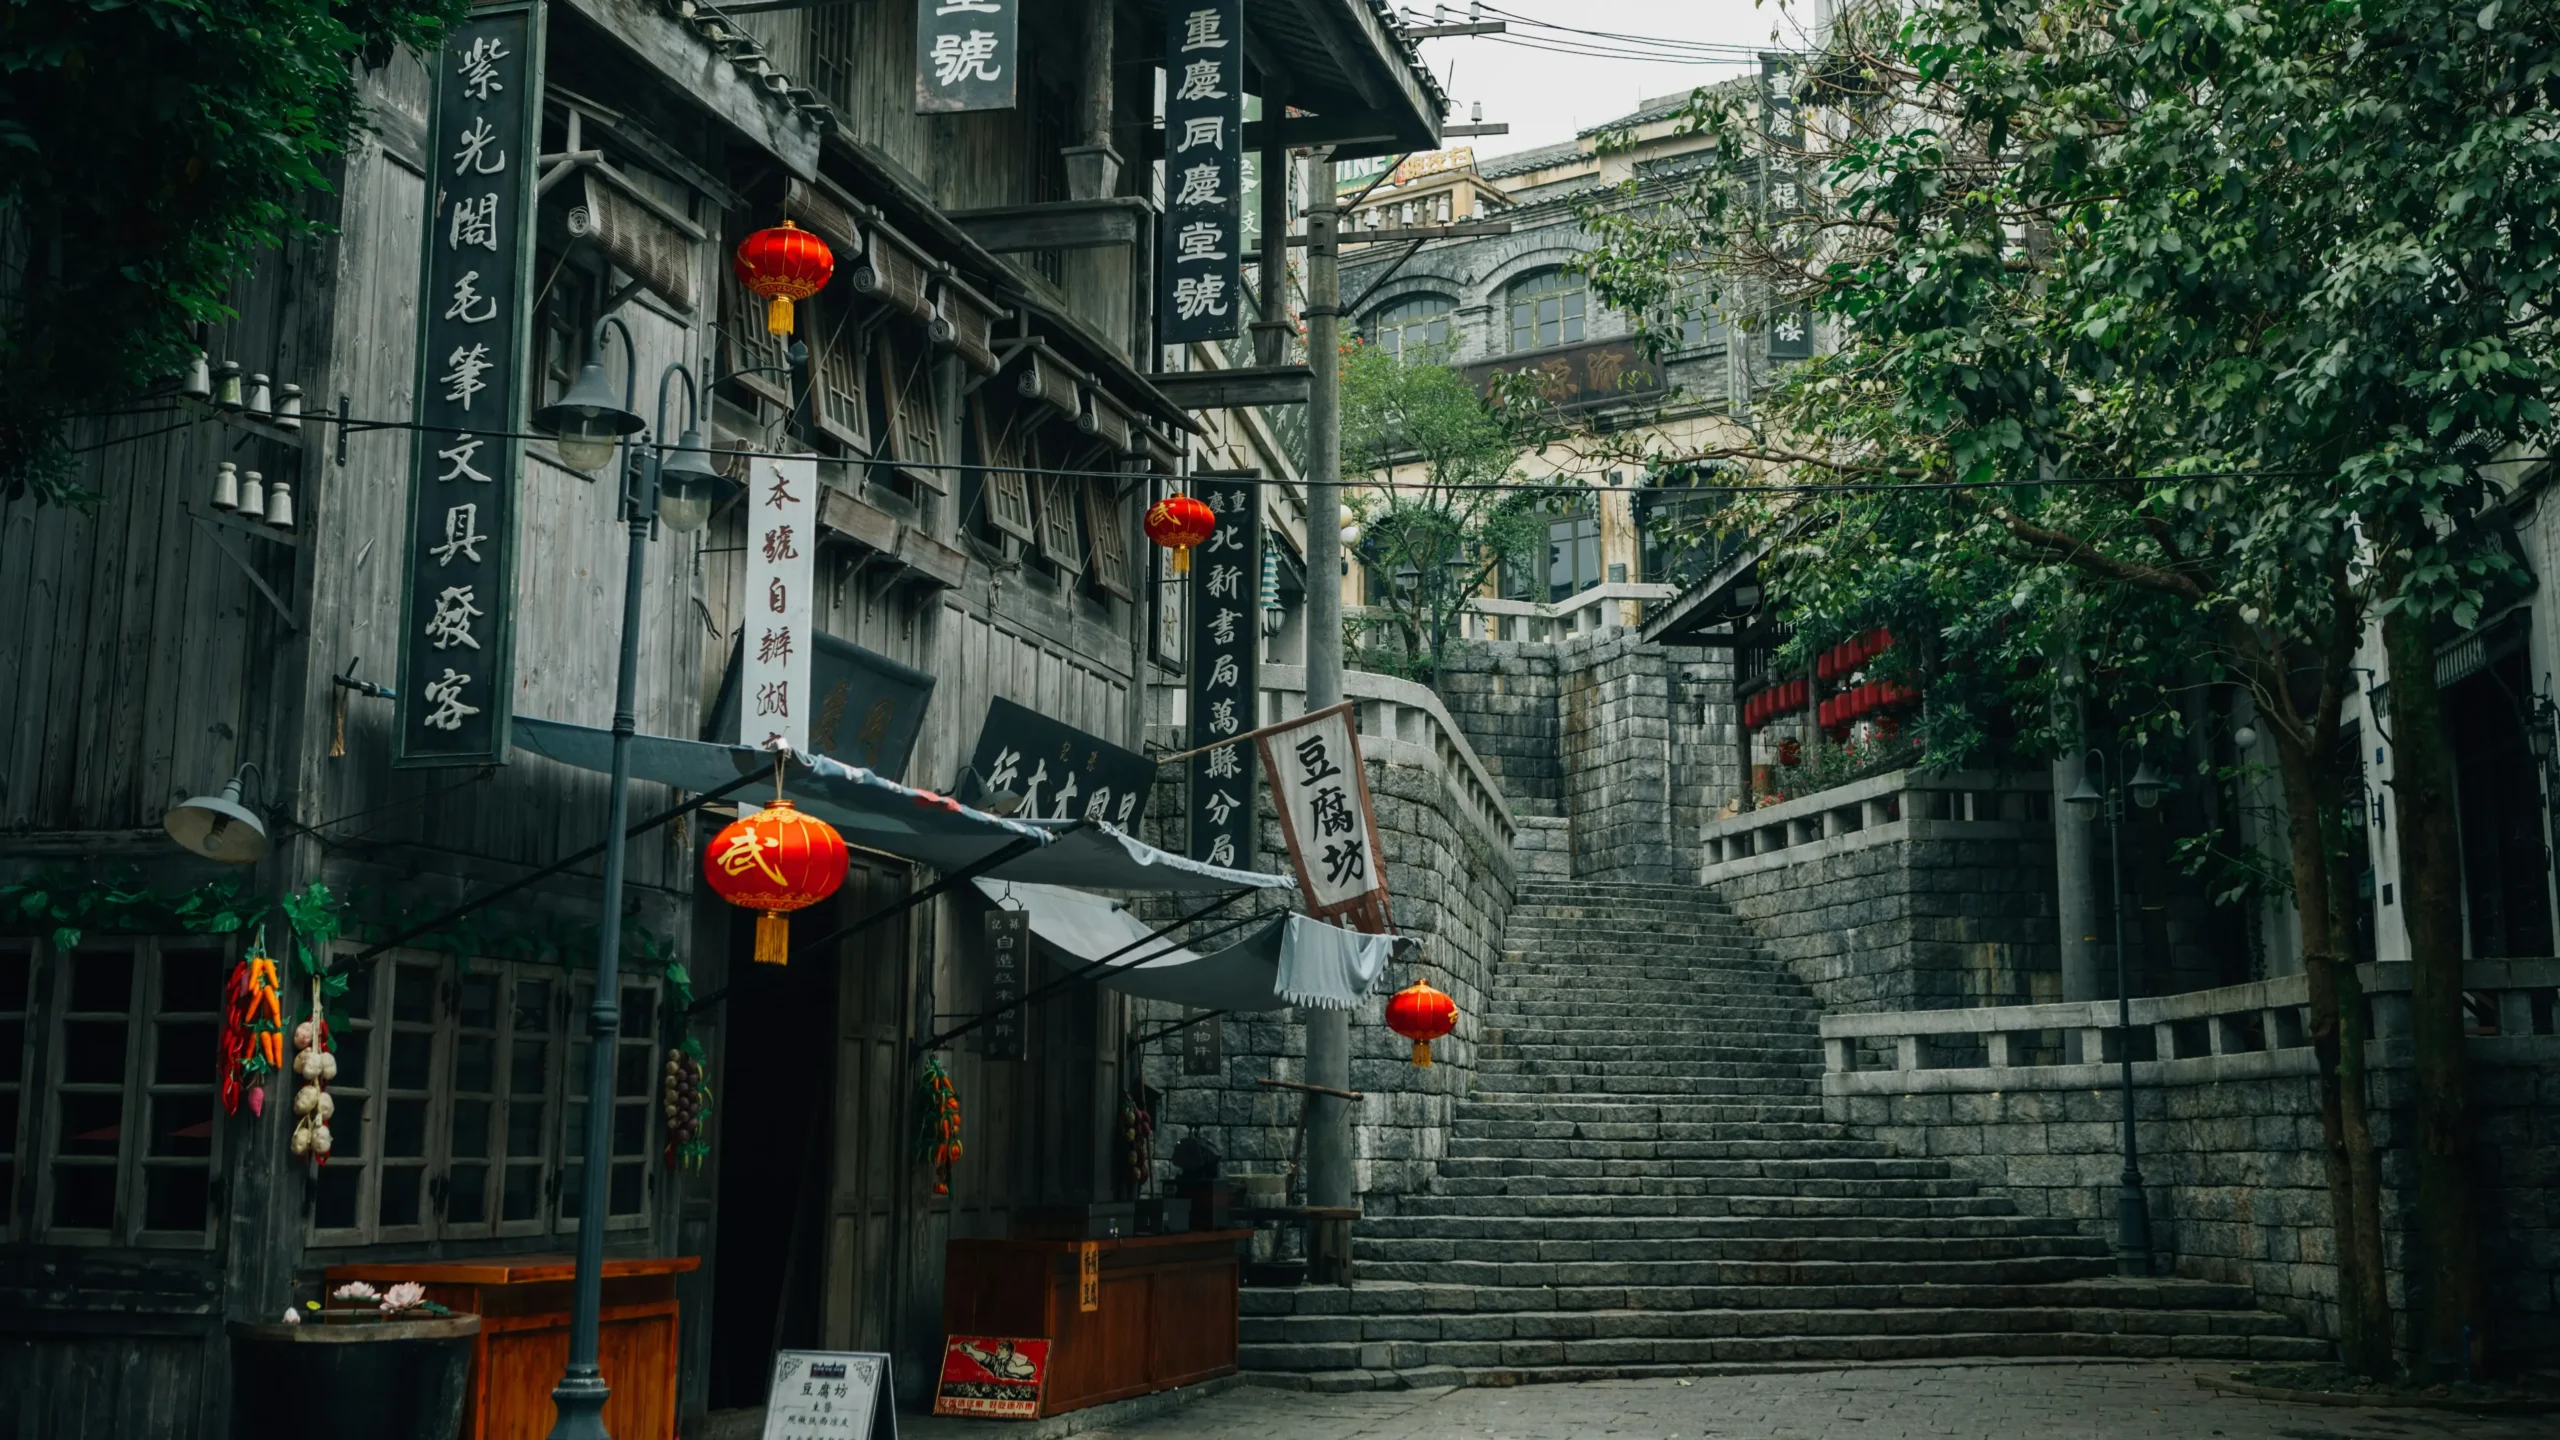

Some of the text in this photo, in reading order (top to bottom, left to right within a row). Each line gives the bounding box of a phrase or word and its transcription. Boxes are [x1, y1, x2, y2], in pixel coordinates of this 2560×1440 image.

[1173, 8, 1228, 321] 重慶同慶堂號
[424, 37, 510, 731] 紫光閣毛筆文具發客
[1148, 502, 1181, 527] 武
[1207, 489, 1247, 514] 重慶
[1205, 524, 1244, 868] 北新書局萬縣分局
[717, 826, 789, 887] 武
[1295, 734, 1365, 889] 豆腐坊
[800, 1381, 849, 1399] 豆腐坊
